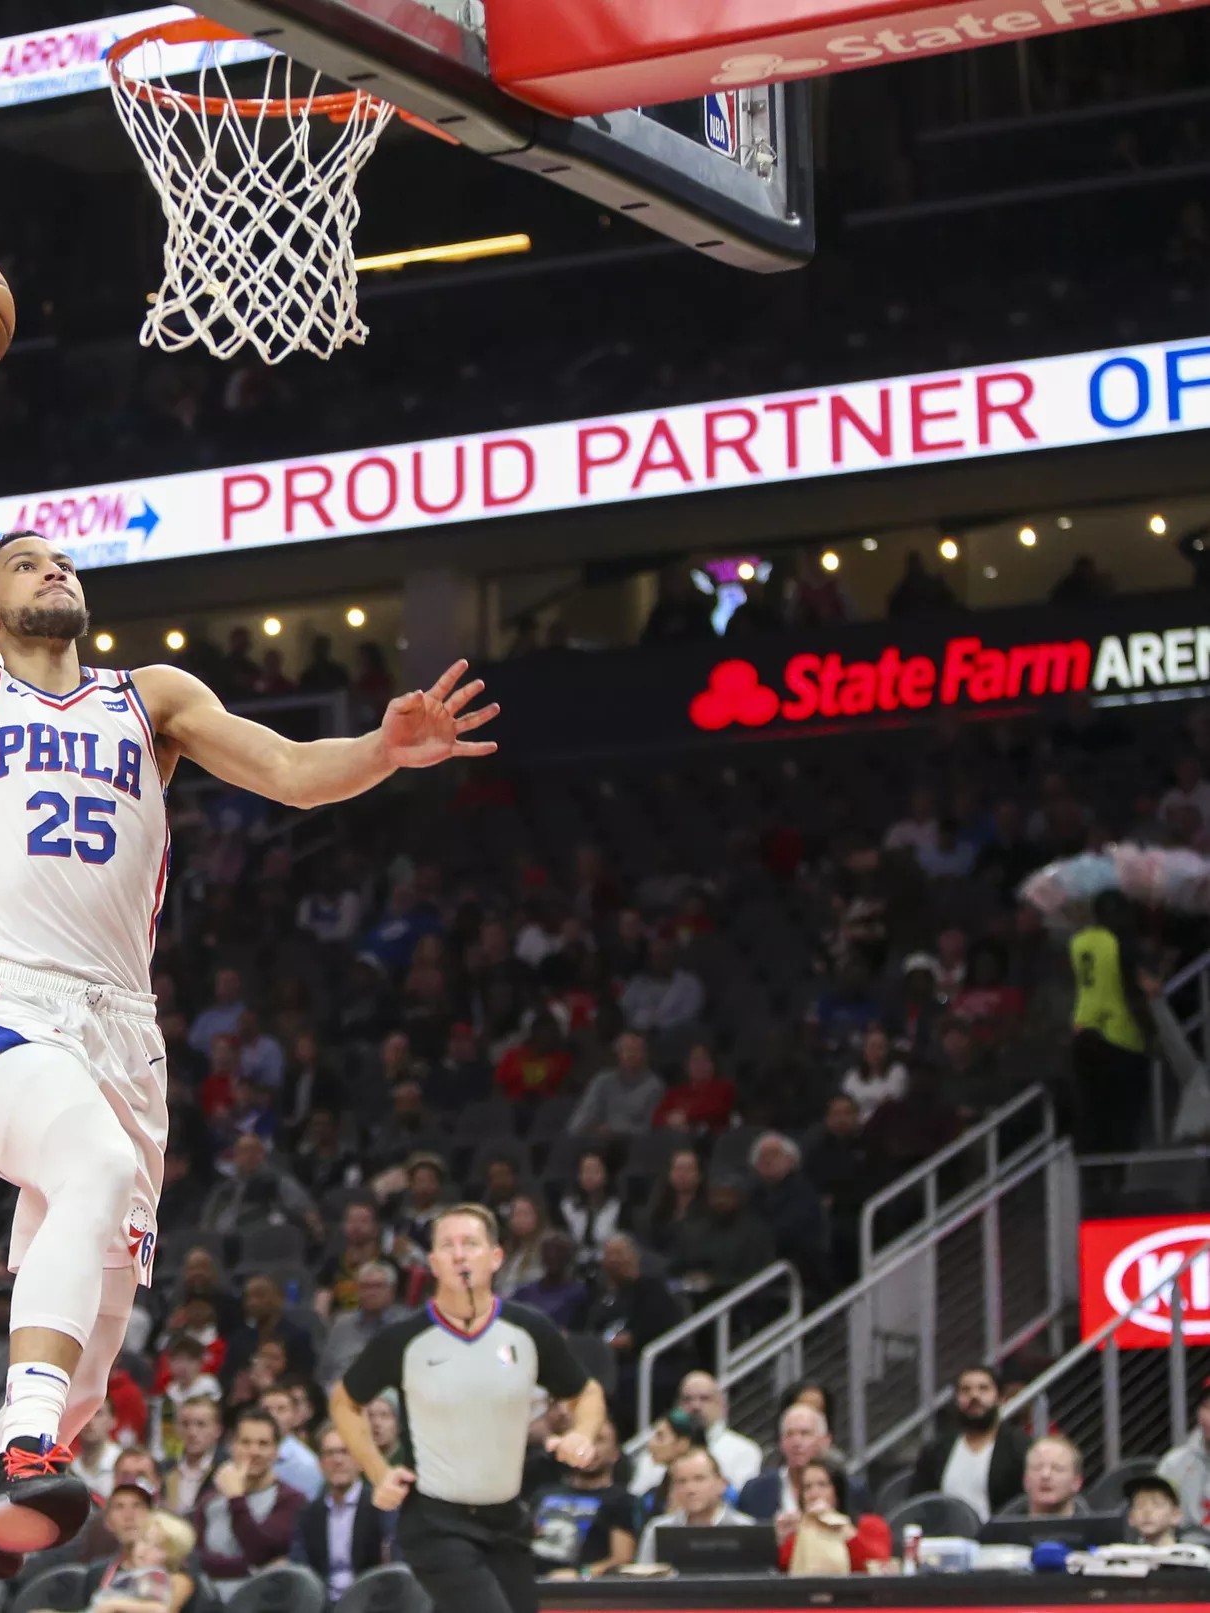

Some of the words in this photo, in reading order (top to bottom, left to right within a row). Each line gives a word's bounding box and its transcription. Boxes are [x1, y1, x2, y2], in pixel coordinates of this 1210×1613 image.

[826, 10, 1042, 62] State
[1042, 0, 1196, 24] Fa
[709, 113, 726, 145] NBA
[222, 438, 536, 541] PROUD
[577, 371, 1039, 496] PARTNER
[782, 646, 936, 720] State
[940, 636, 1091, 704] Farm
[26, 790, 117, 865] 25
